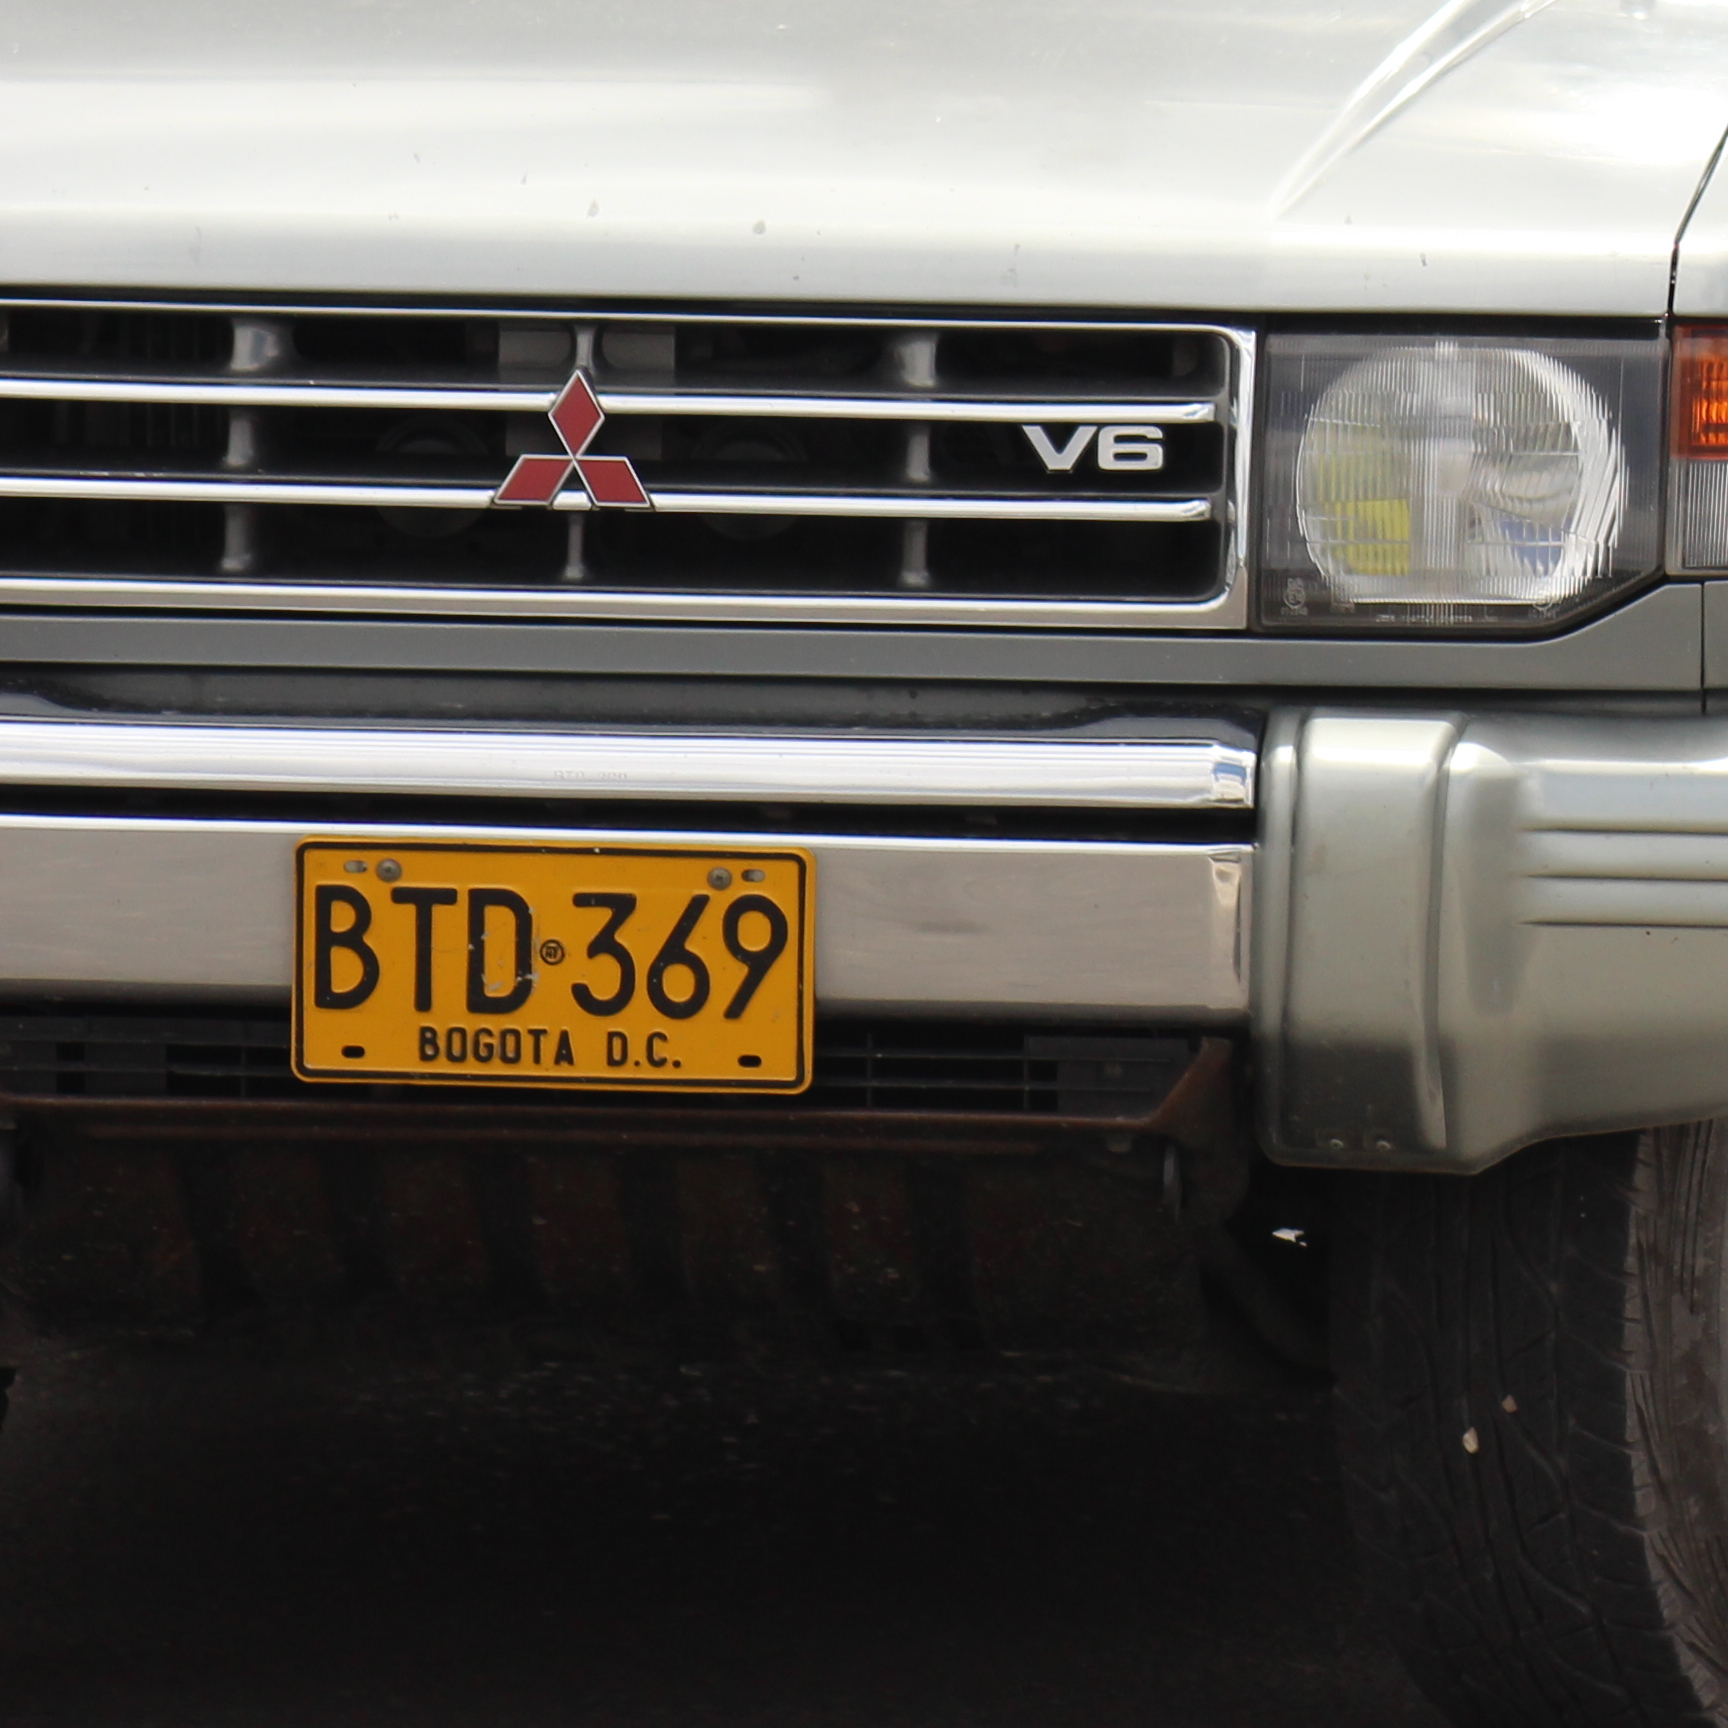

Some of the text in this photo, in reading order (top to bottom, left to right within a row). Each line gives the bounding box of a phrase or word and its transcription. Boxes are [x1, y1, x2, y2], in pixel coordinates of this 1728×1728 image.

[1022, 425, 1164, 471] V6
[314, 884, 789, 1020] BTD 369
[418, 1025, 684, 1069] BOGOTA D.C.
